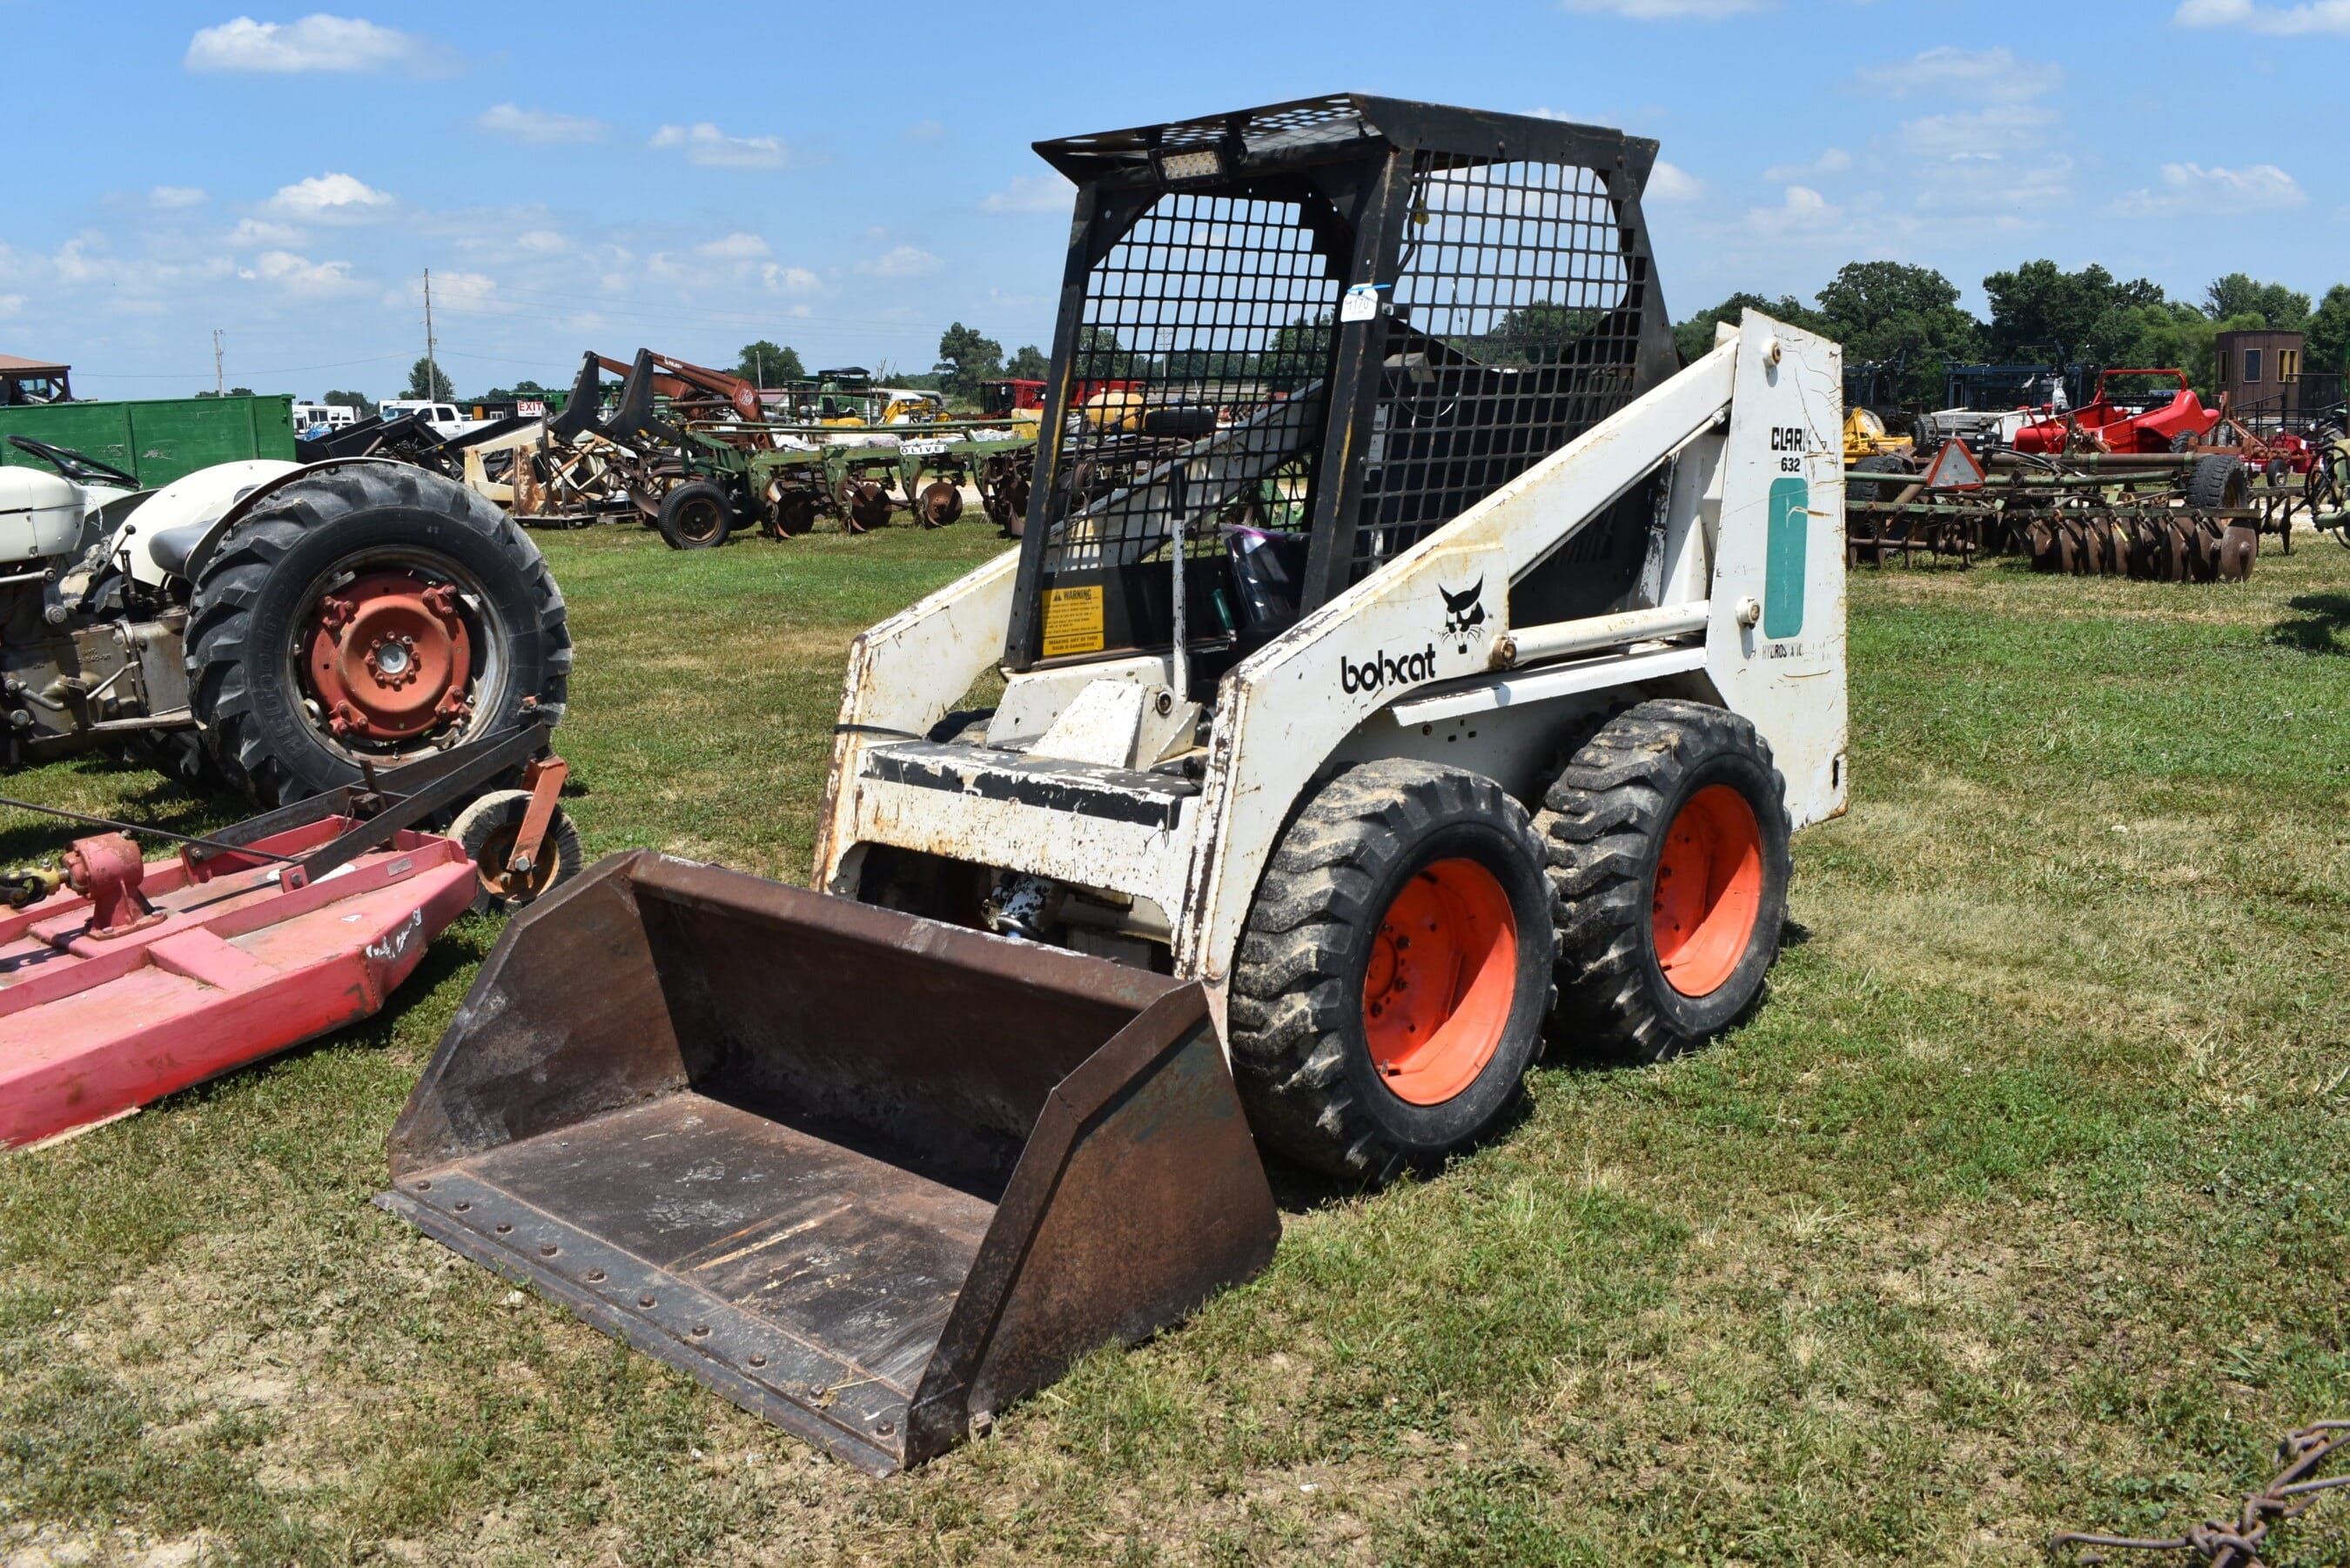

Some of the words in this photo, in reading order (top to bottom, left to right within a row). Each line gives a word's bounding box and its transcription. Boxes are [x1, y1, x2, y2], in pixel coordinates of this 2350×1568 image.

[519, 401, 541, 412] EXIT
[1781, 456, 1801, 472] 632
[1063, 588, 1092, 601] WARNING
[1341, 643, 1436, 694] bobcat
